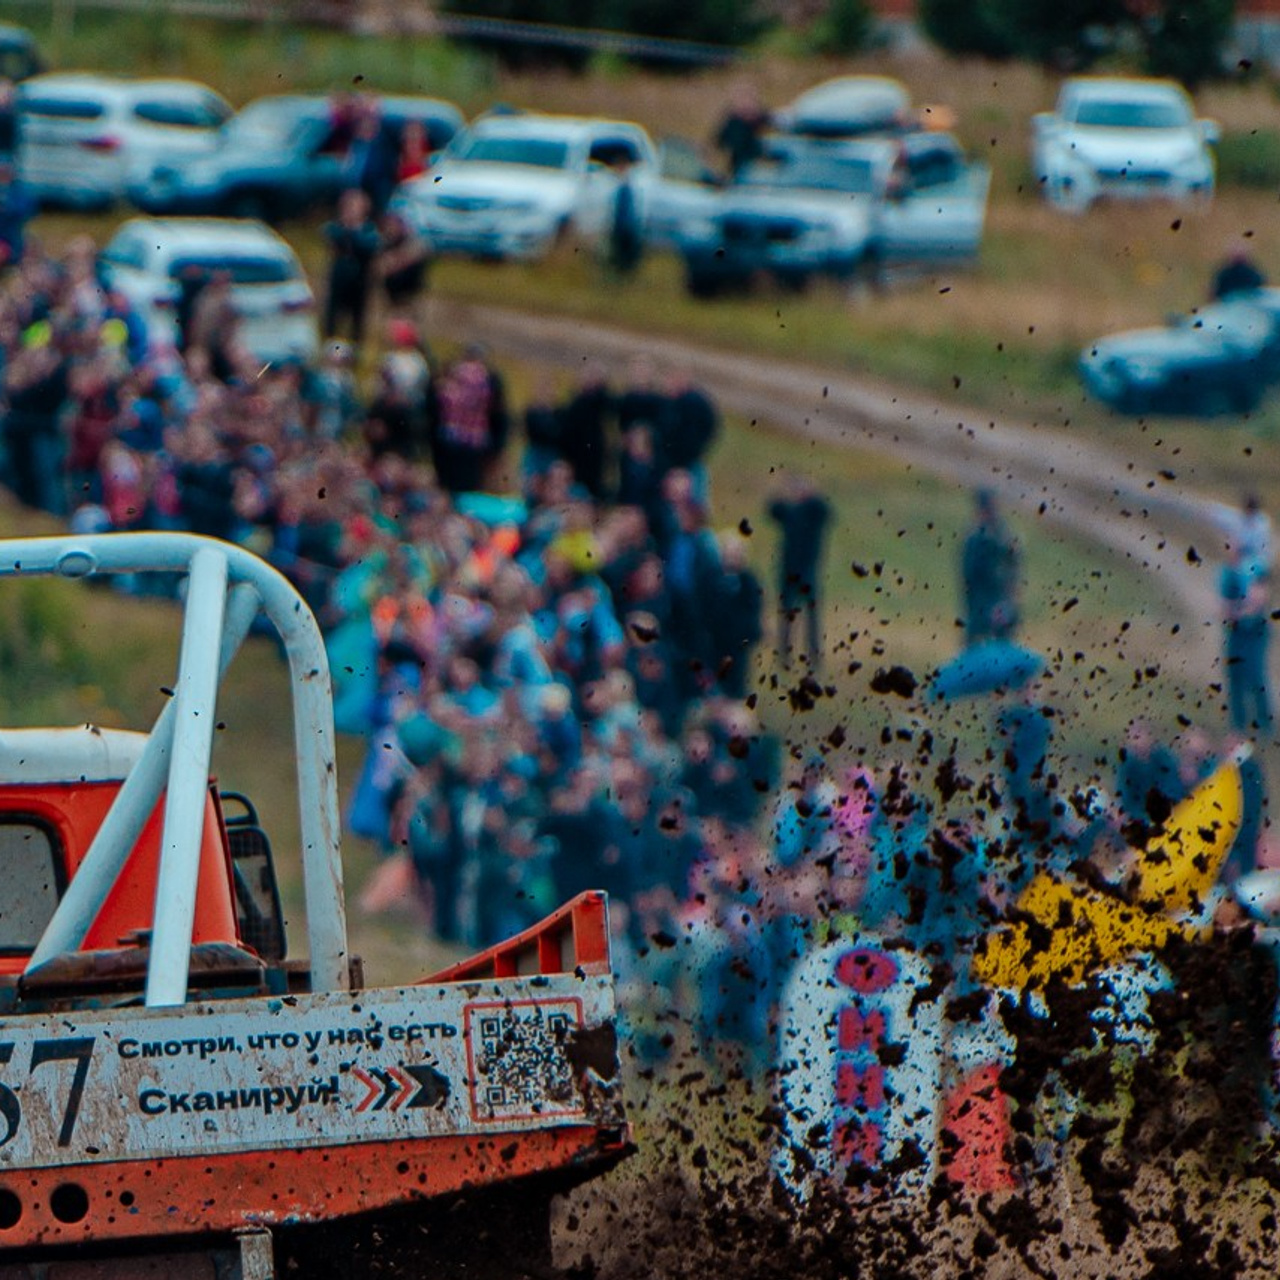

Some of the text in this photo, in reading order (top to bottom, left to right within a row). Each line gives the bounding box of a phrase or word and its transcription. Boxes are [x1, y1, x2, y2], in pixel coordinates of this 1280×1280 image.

[117, 1021, 458, 1060] Смотри, что у нас есть
[138, 1074, 341, 1116] Сканируй!
